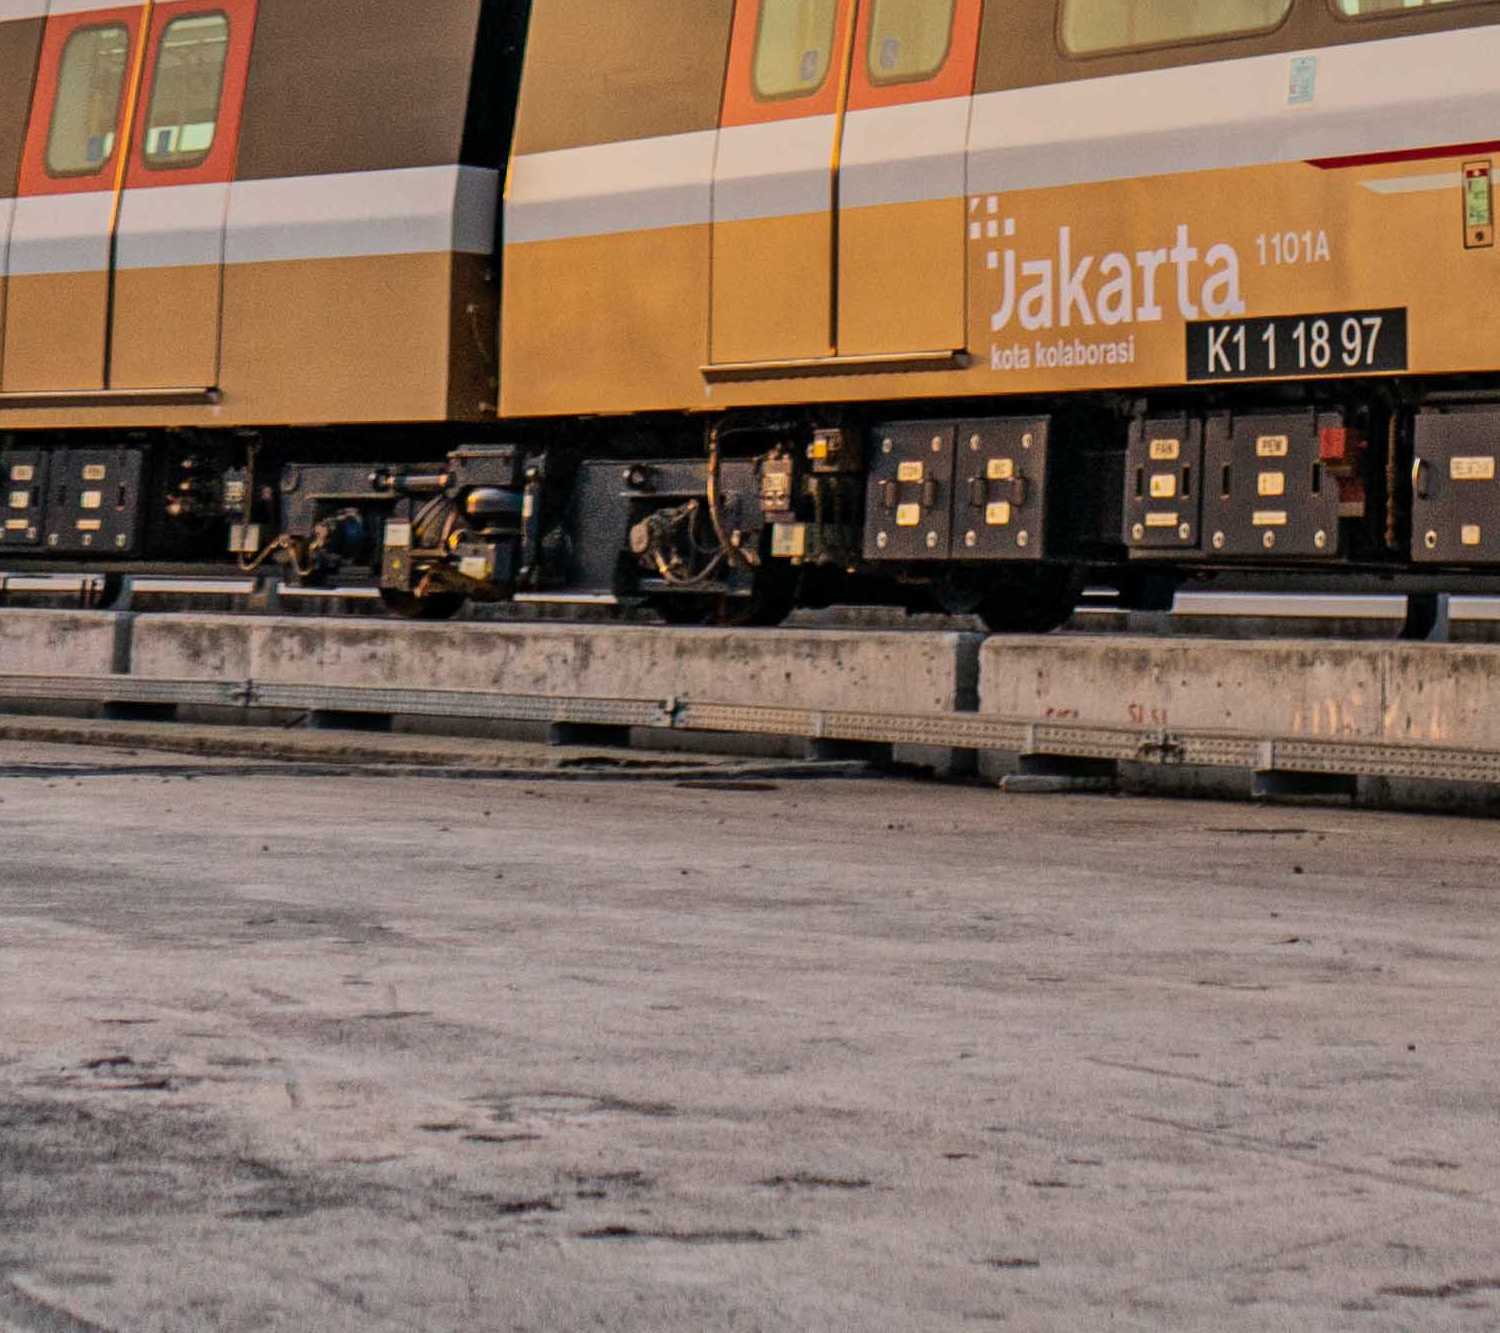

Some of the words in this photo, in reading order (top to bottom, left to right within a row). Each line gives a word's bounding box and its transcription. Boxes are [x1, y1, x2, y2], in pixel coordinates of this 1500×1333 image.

[1256, 229, 1331, 266] 1101A
[987, 223, 1246, 332] Jakarta
[990, 342, 1031, 370] kota
[1035, 334, 1136, 368] kolaborasi
[1207, 324, 1246, 373] K1
[1261, 322, 1276, 370] 1
[1292, 319, 1331, 369] 18
[1340, 316, 1382, 367] 97
